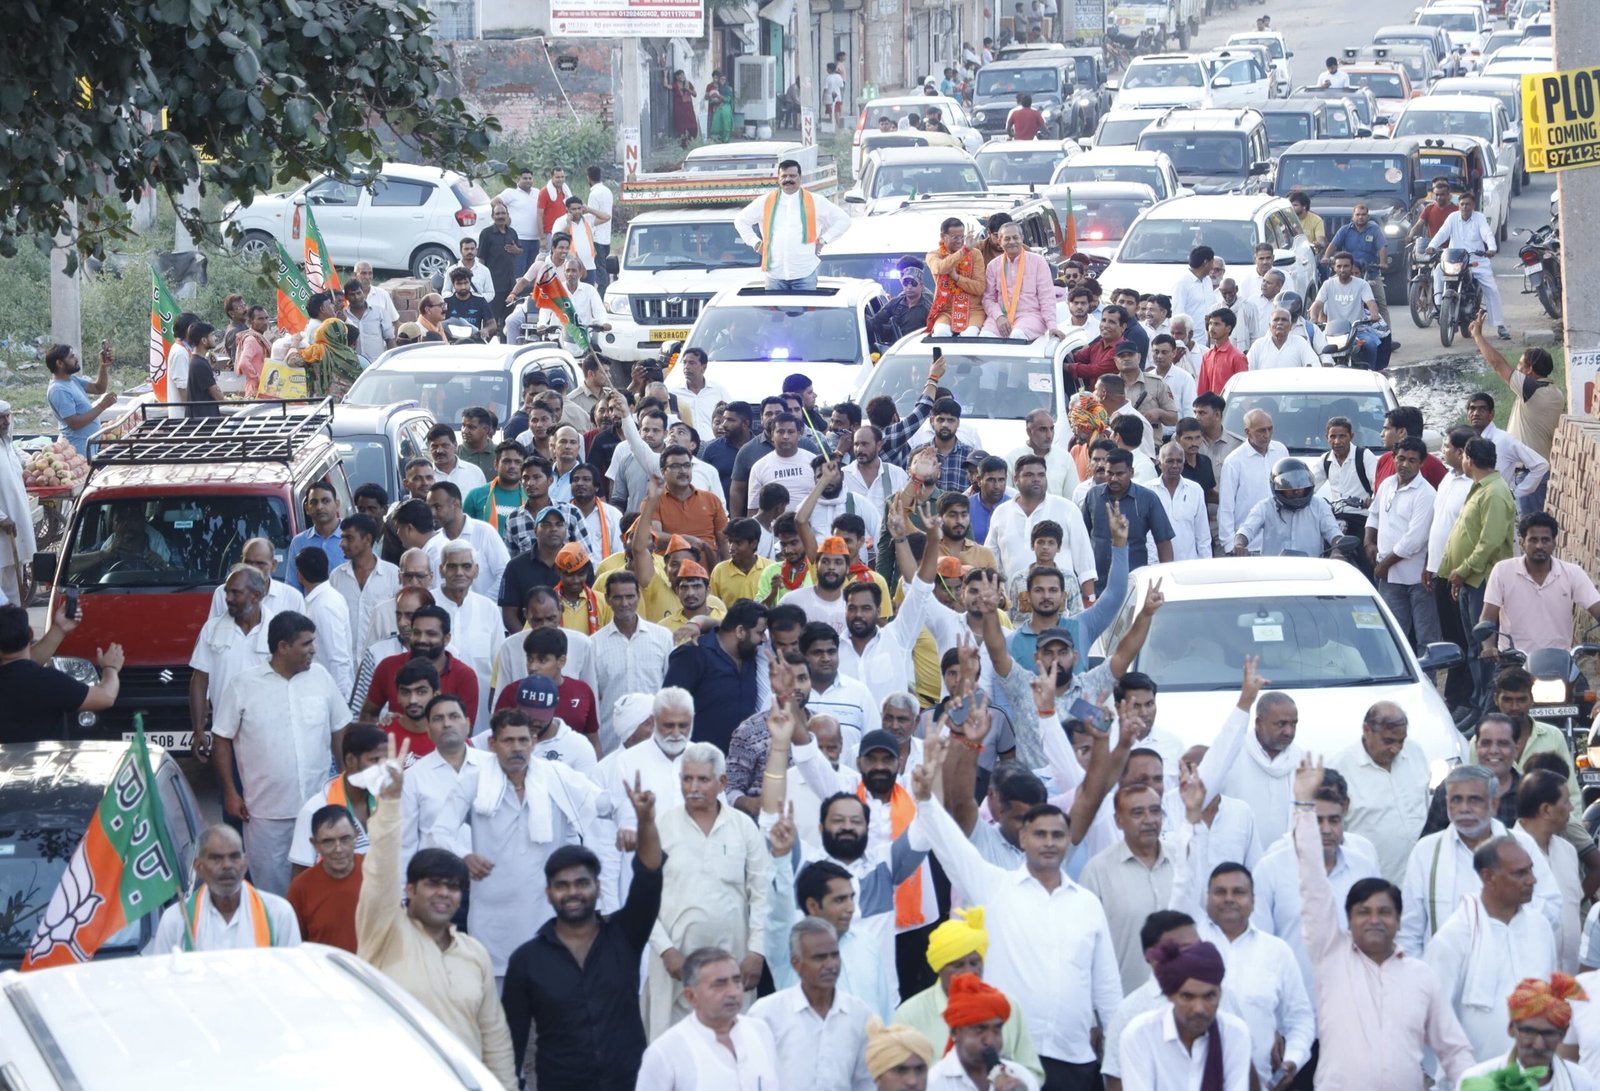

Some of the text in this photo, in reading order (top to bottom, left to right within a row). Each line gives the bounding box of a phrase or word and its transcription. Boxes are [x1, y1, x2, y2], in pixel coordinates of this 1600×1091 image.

[1547, 121, 1597, 146] COMING
[1549, 144, 1600, 166] 971125
[774, 467, 803, 478] PRIVATE
